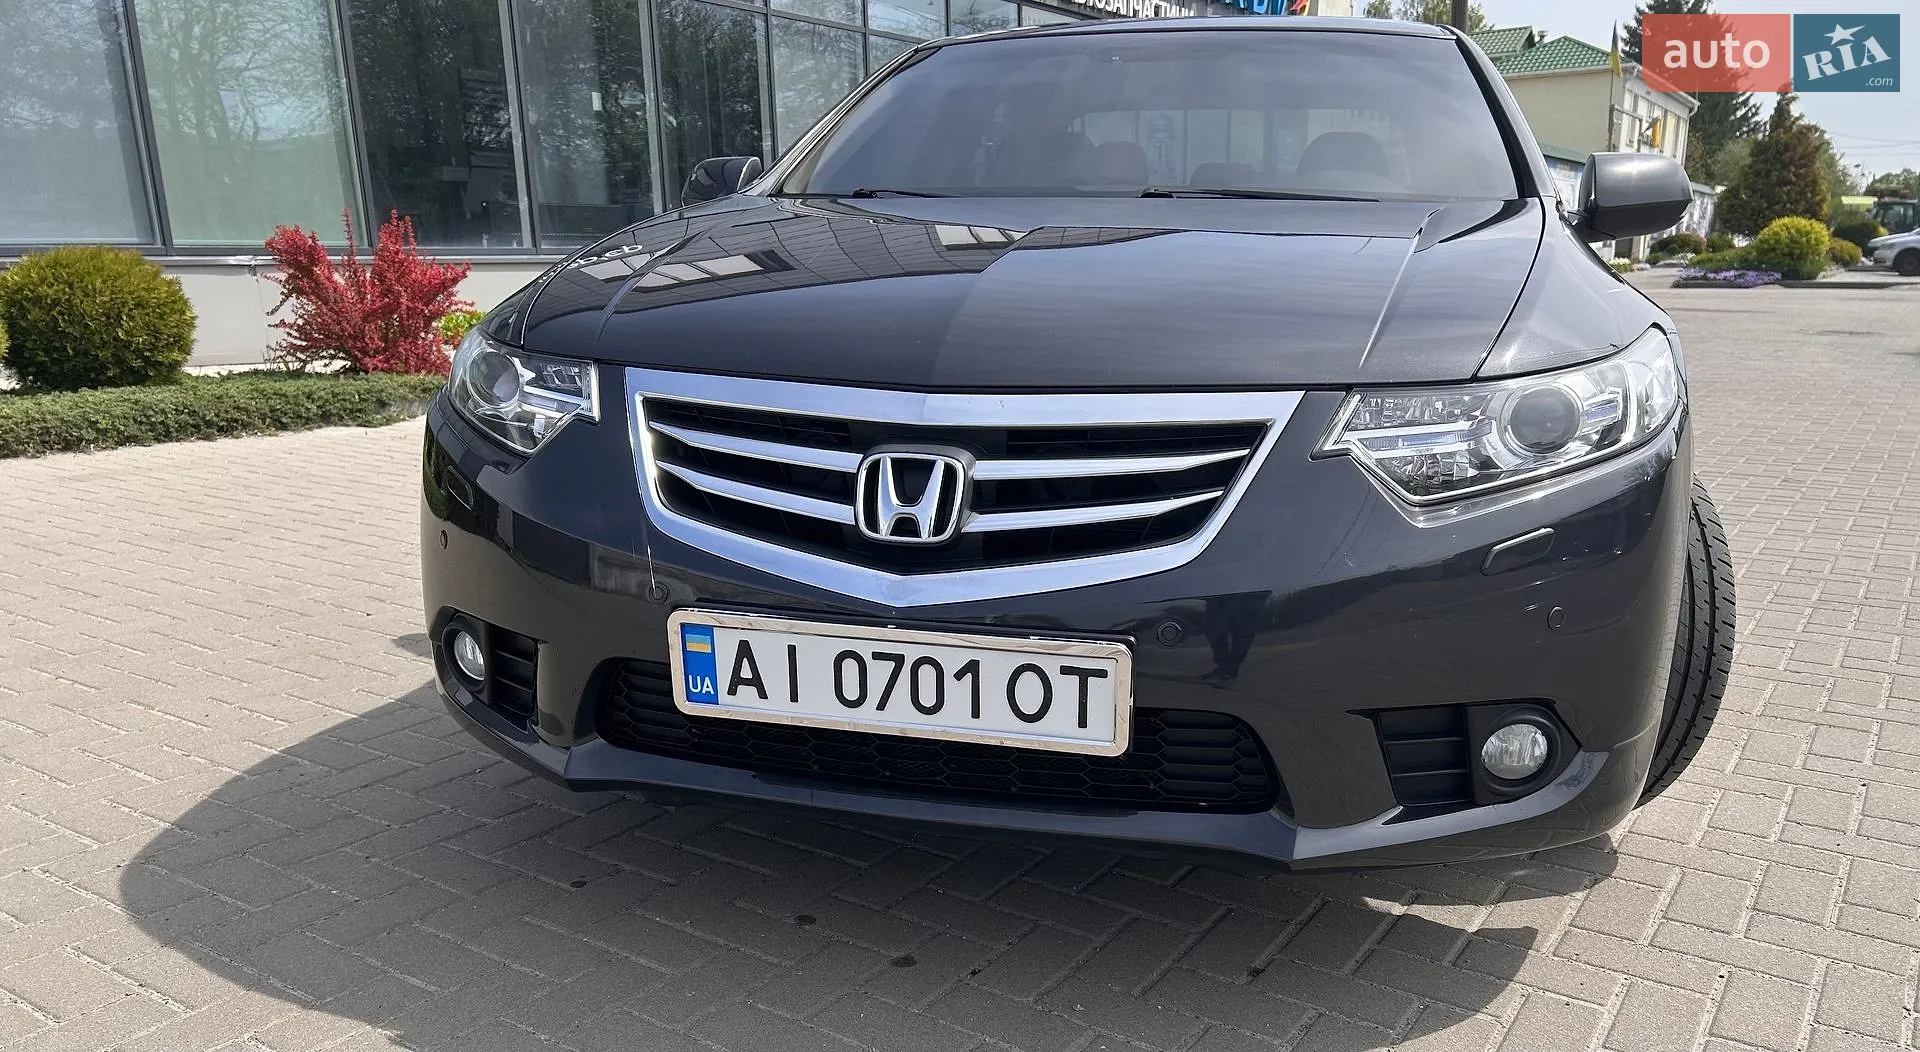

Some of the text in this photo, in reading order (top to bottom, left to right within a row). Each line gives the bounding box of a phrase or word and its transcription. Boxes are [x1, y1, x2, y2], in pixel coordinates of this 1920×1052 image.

[688, 674, 715, 695] UA
[726, 639, 1108, 729] AI 0701 OT
